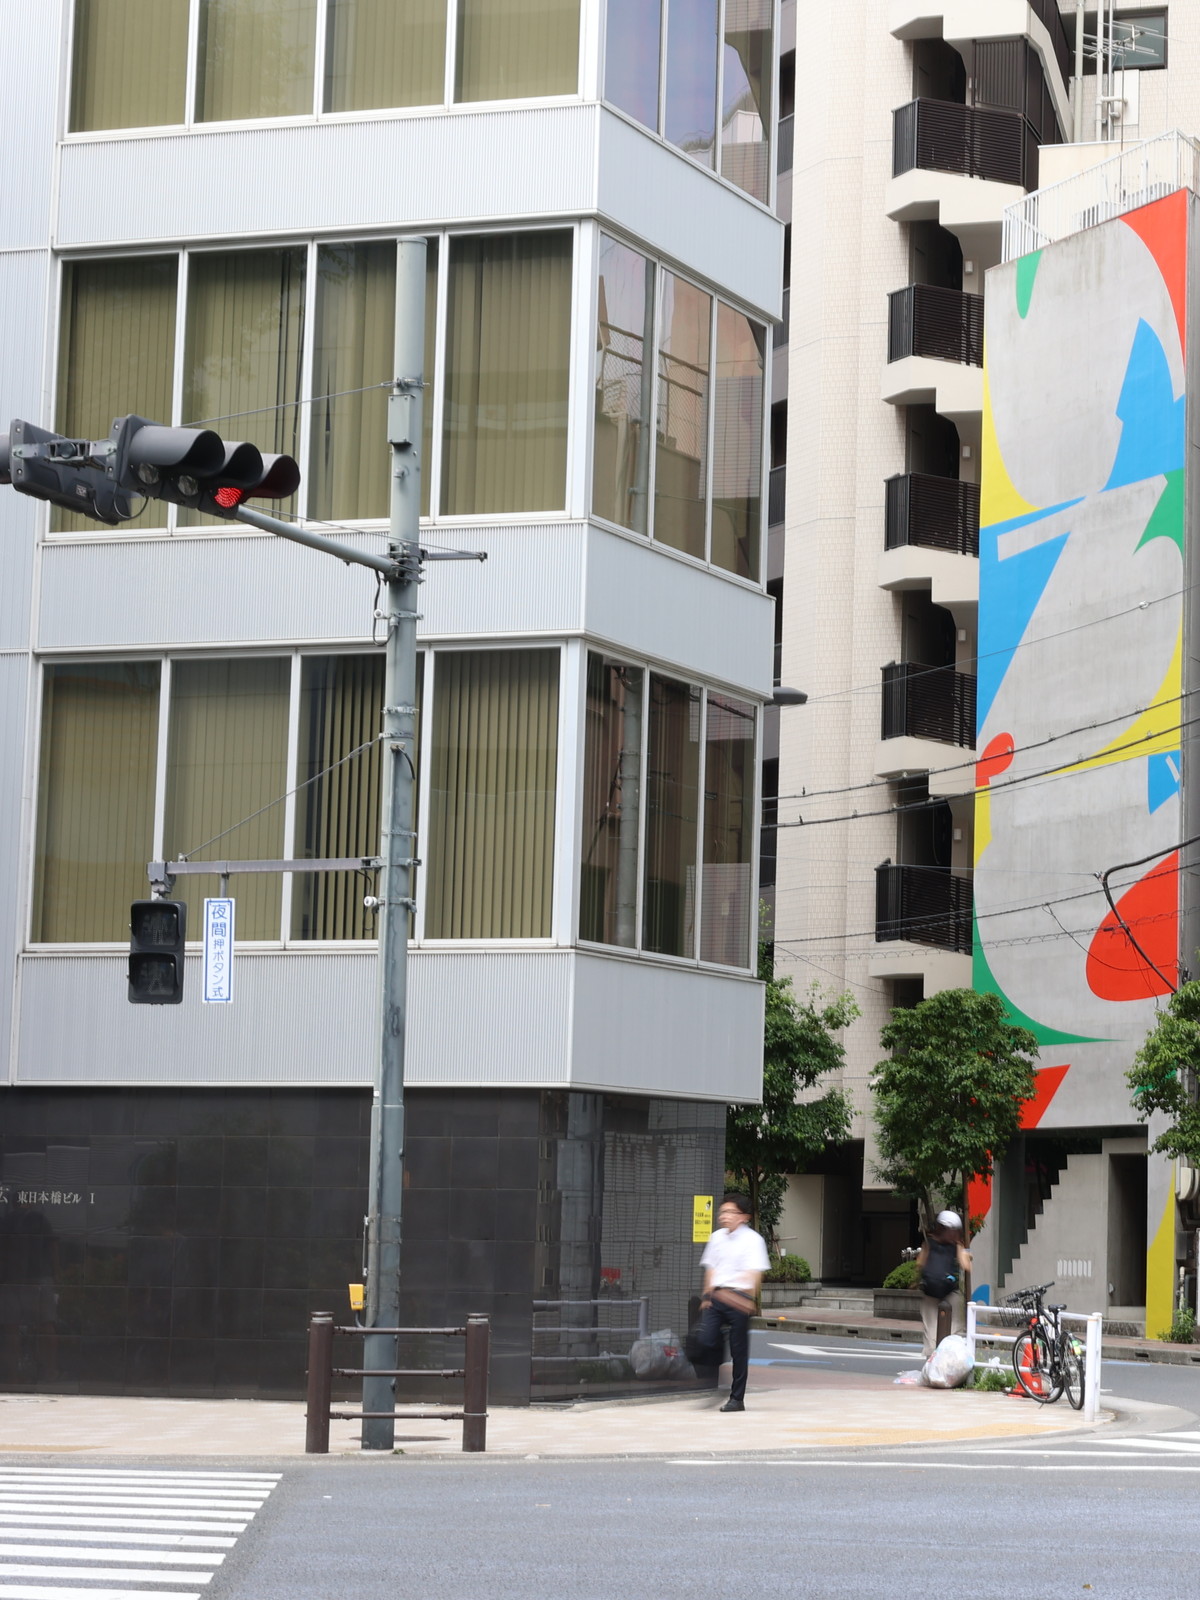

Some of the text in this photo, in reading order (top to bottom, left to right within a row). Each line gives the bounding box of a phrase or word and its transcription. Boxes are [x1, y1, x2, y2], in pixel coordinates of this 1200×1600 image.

[211, 904, 227, 998] 夜間押ボタン式
[17, 1191, 82, 1204] 東日本橋ビル
